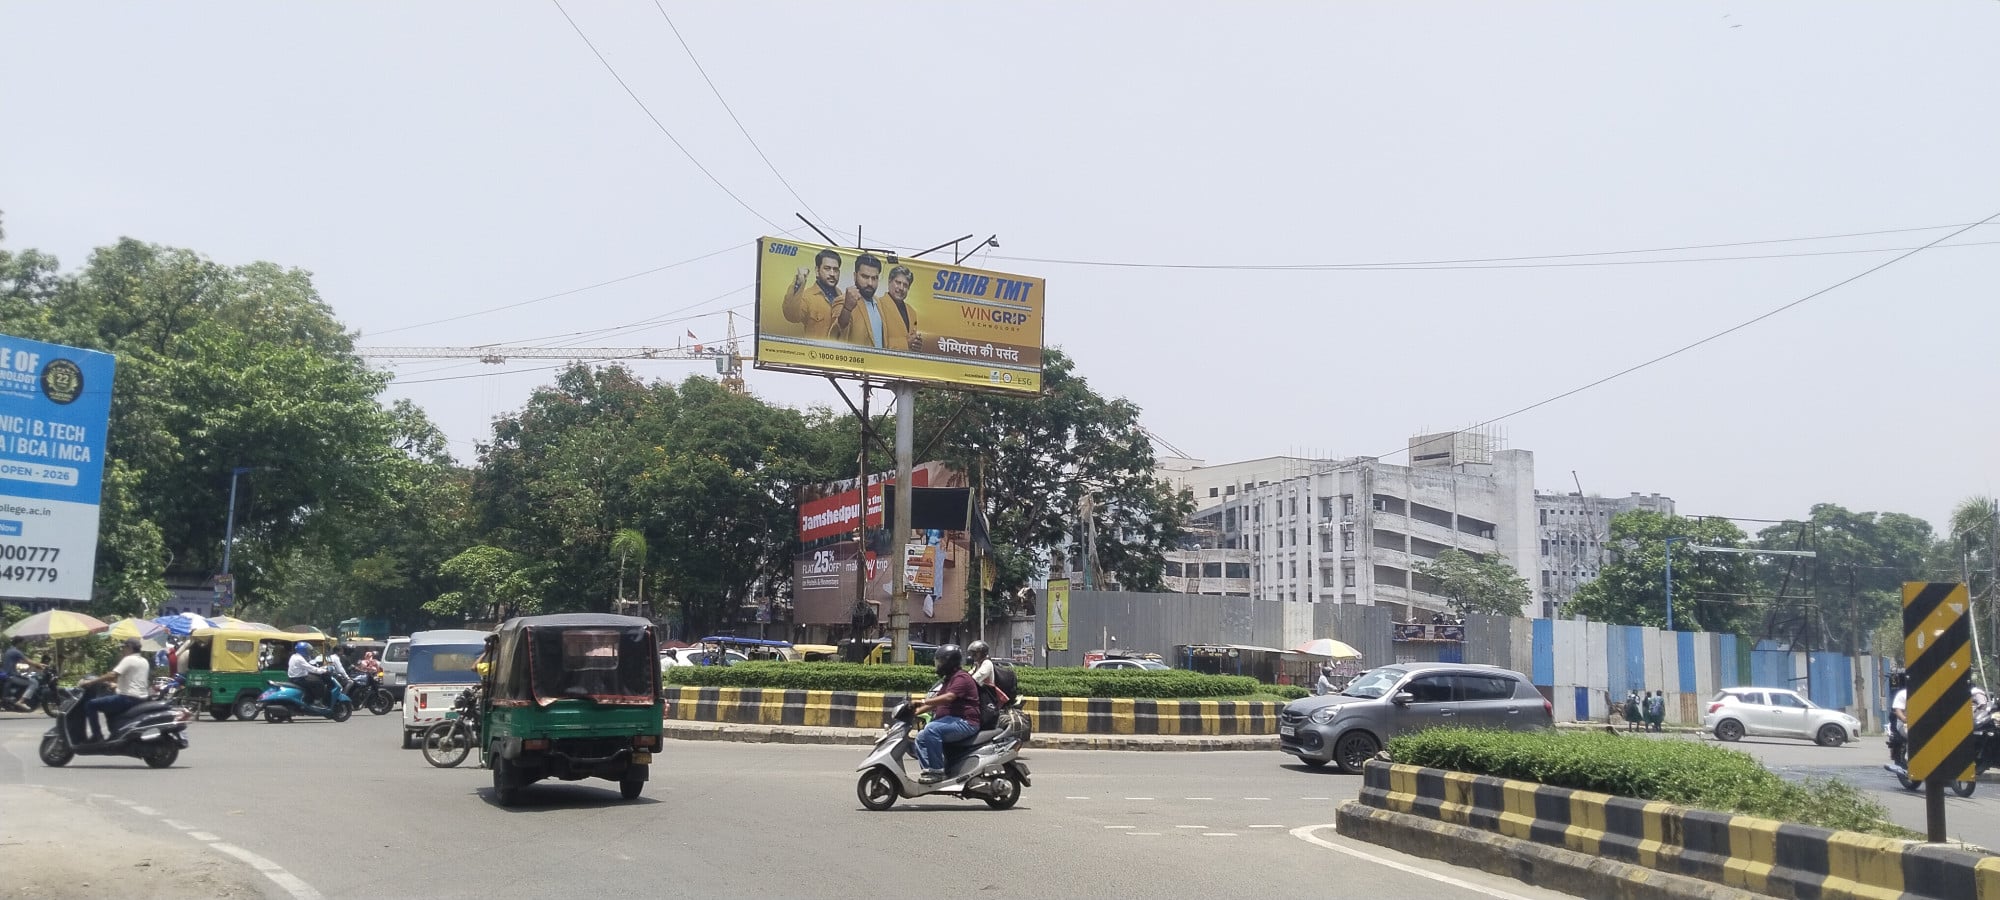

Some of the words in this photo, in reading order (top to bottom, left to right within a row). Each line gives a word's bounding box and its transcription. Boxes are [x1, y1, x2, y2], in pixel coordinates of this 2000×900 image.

[769, 243, 798, 256] SRMB
[933, 270, 990, 296] SRMB
[995, 278, 1033, 302] TMT
[961, 305, 1027, 325] WINGRIP
[967, 321, 1020, 331] TECHNOLOGY
[938, 336, 978, 356] चैम्पियंस
[980, 344, 993, 358] की
[996, 346, 1019, 362] पसंद
[15, 351, 40, 373] OF
[56, 374, 69, 384] 22
[0, 414, 24, 433] NIC
[33, 420, 86, 442] B.TECH
[17, 438, 48, 457] BCA
[58, 443, 91, 462] MCA
[1, 465, 32, 476] OPEN
[42, 470, 70, 480] 2026
[0, 565, 58, 582] 49779
[803, 564, 814, 574] FLAT
[846, 560, 858, 571] mak
